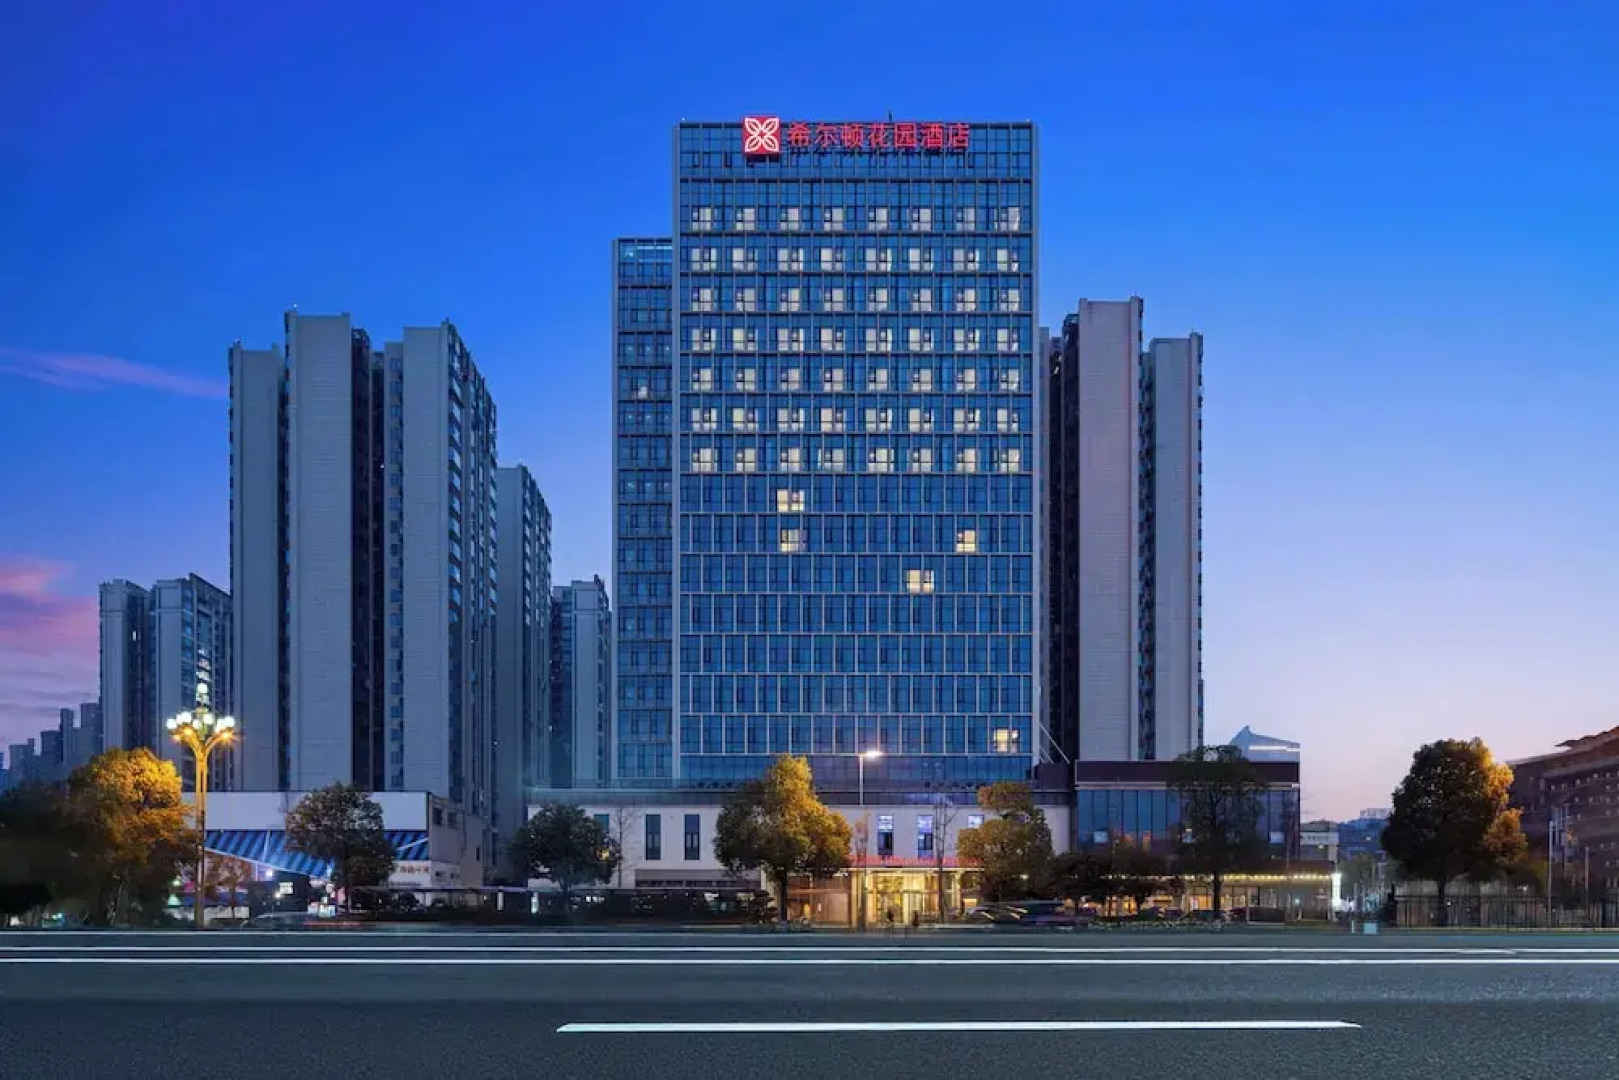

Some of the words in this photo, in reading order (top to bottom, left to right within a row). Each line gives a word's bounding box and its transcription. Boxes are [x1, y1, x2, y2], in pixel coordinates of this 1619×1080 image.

[787, 122, 970, 148] 希尔顿花园酒店
